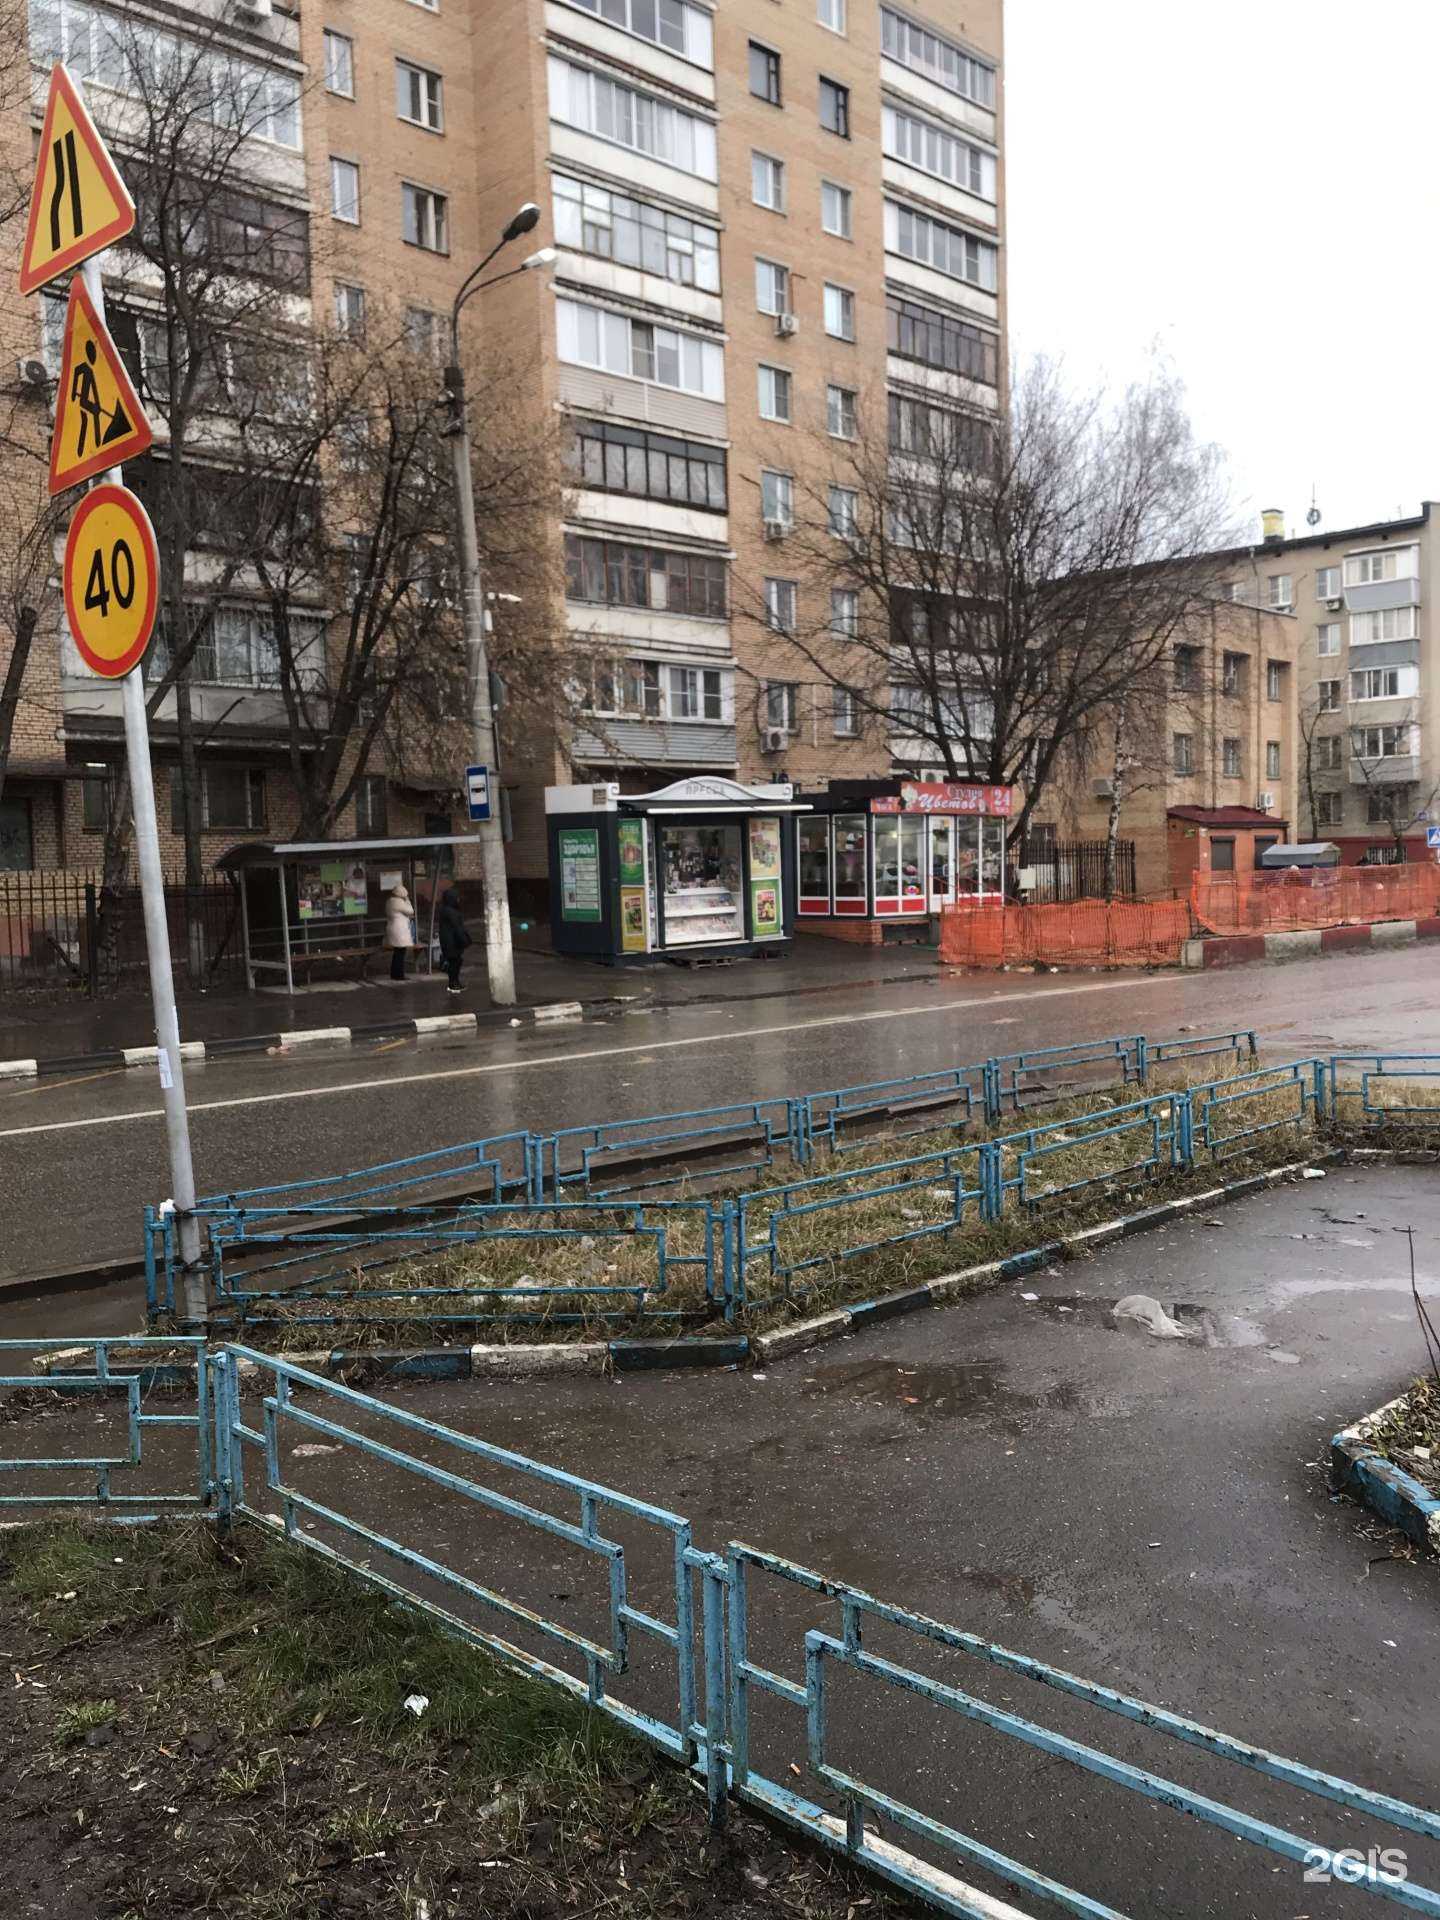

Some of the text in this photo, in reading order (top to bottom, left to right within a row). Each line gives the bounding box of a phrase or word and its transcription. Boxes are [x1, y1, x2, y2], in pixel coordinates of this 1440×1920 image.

[85, 539, 135, 617] 40
[919, 793, 976, 813] Цветов
[994, 788, 1010, 806] 24
